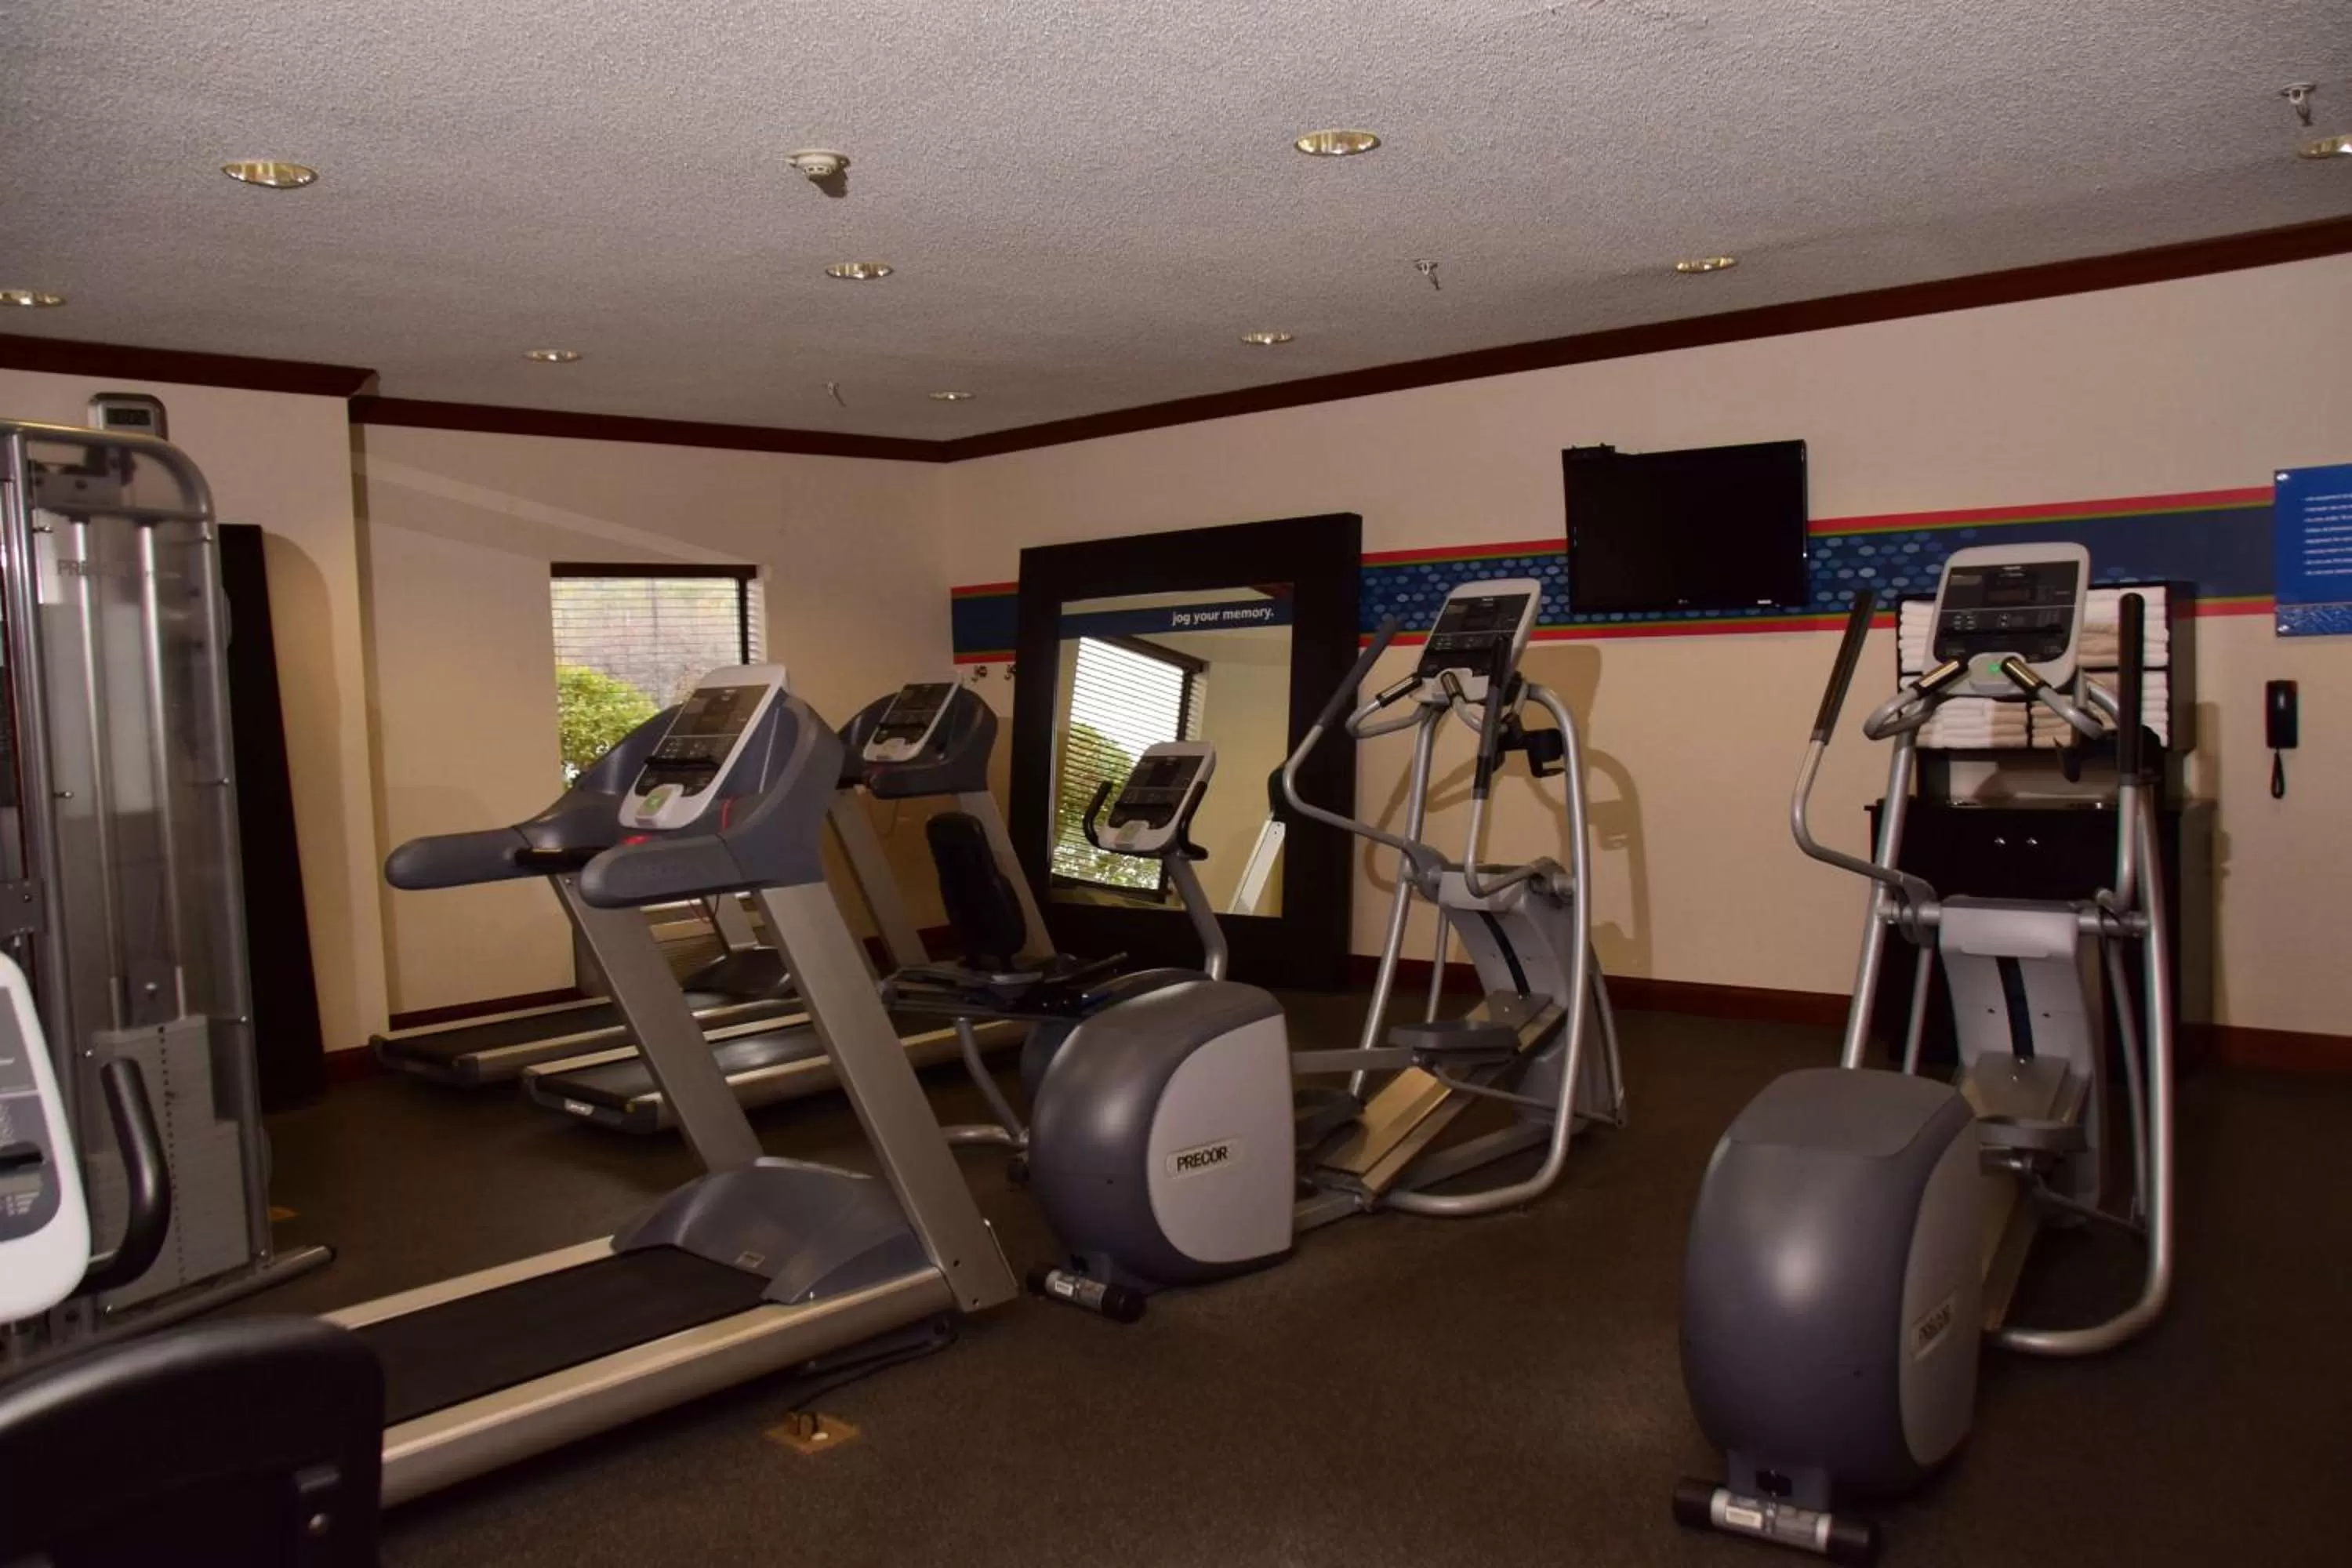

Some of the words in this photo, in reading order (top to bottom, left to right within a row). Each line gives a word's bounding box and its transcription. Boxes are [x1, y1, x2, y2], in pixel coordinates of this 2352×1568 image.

[1172, 612, 1191, 626] jog
[1194, 612, 1220, 624] your
[1223, 608, 1274, 621] memory.
[1177, 1146, 1228, 1171] PRECOR
